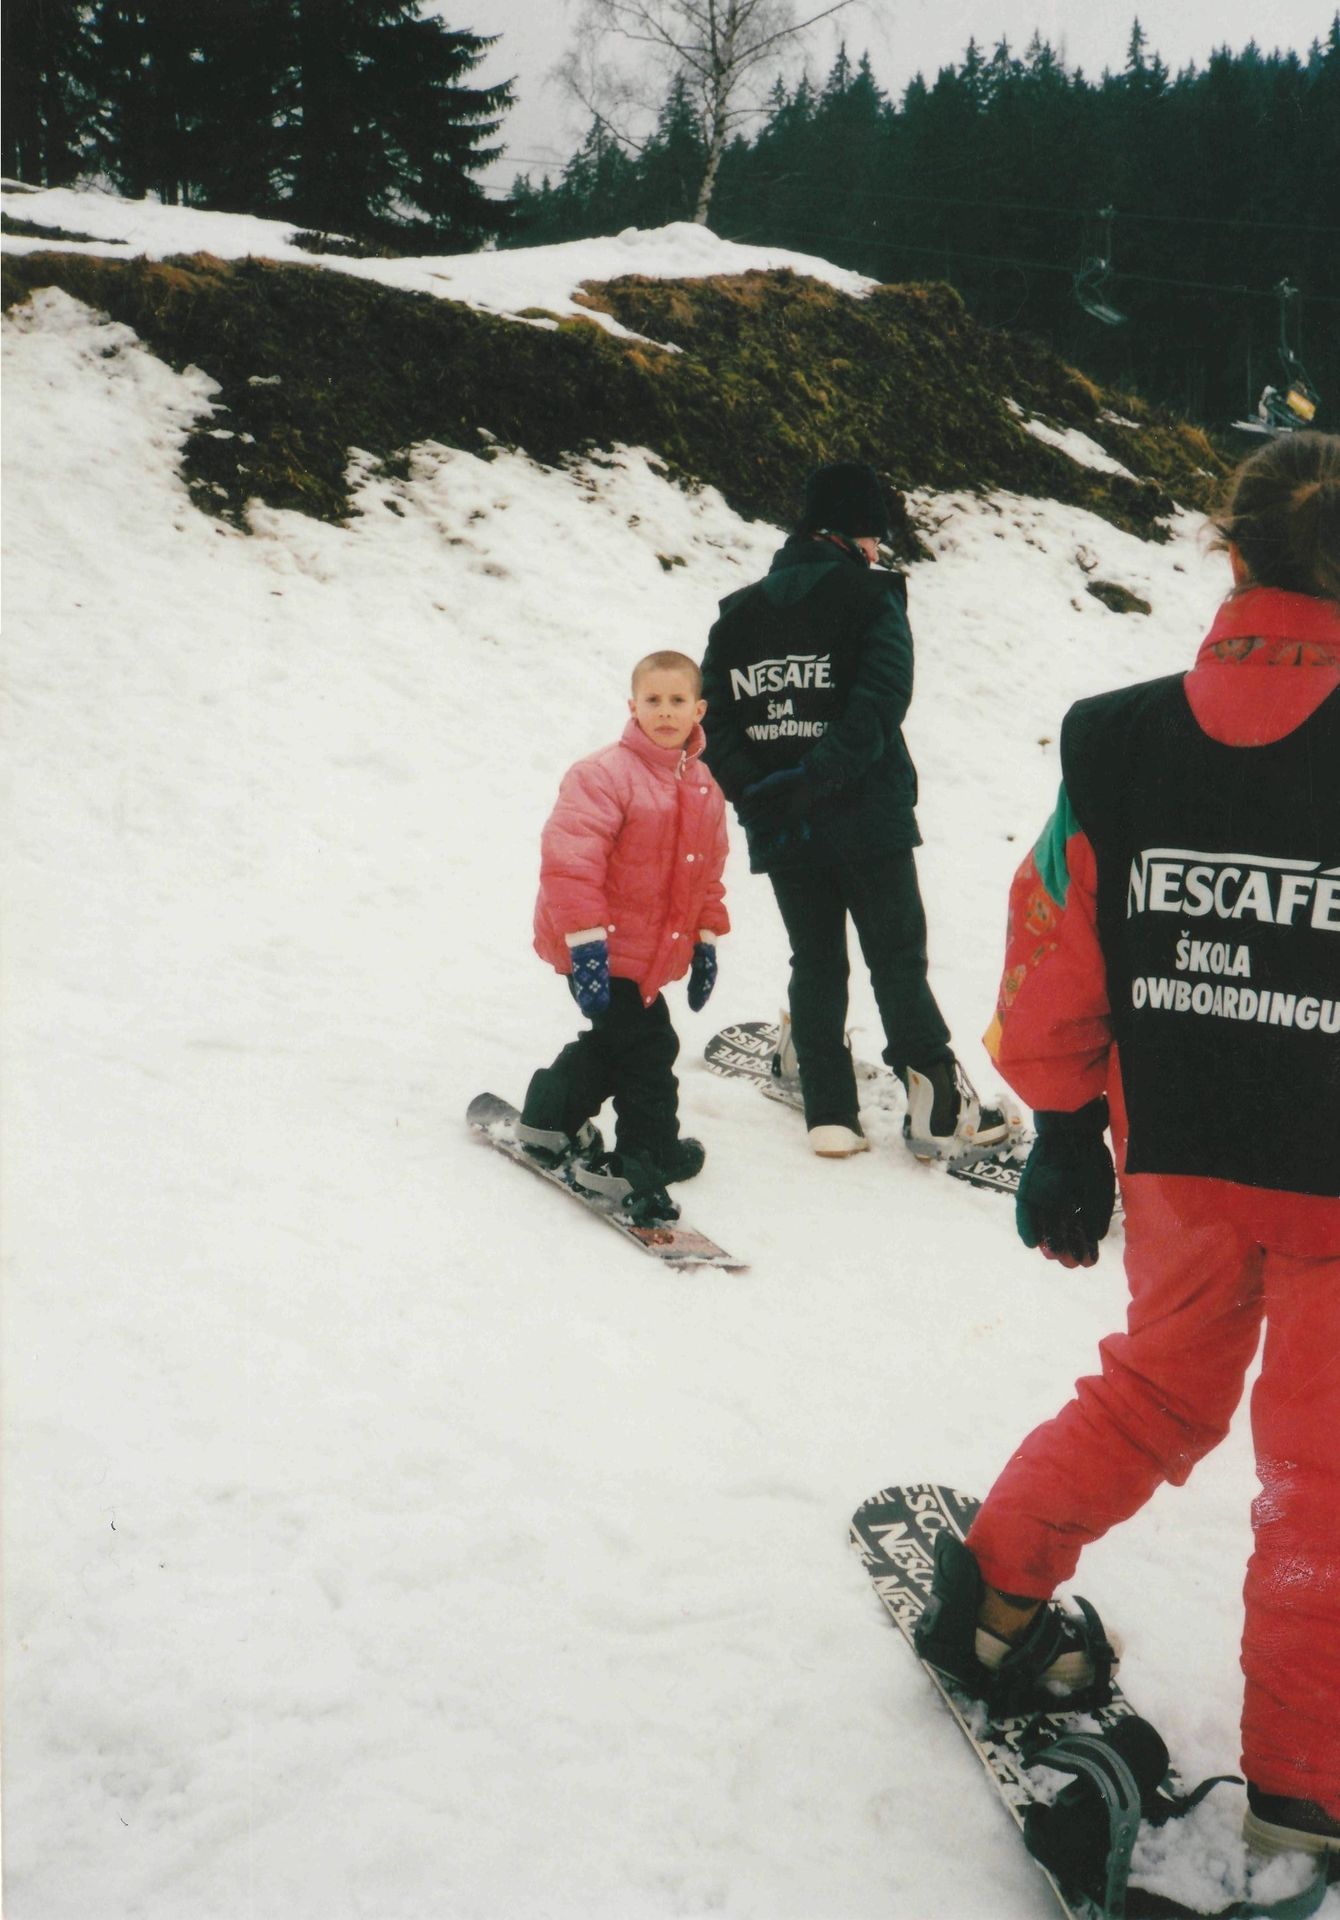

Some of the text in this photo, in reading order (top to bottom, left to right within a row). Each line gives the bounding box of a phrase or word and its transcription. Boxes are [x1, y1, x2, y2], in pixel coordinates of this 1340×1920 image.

[729, 653, 831, 701] NESAFÉ
[1175, 929, 1251, 978] ŠKOLA
[1132, 976, 1340, 1034] OWBOARDINGU
